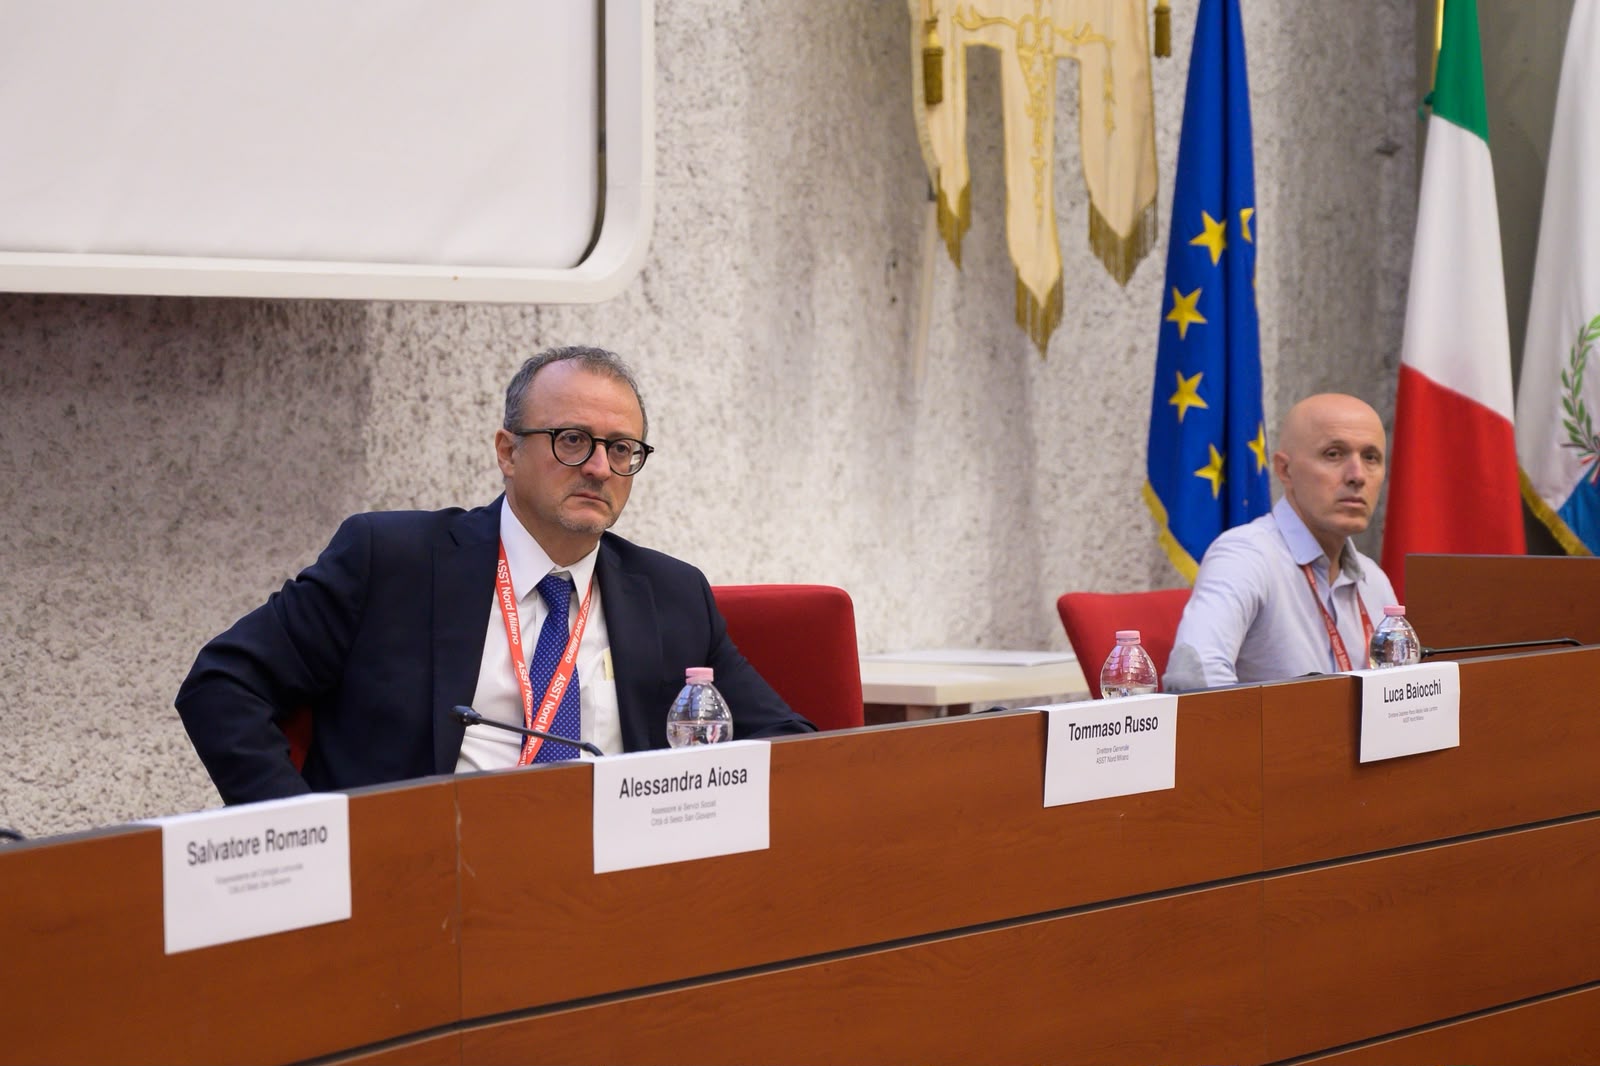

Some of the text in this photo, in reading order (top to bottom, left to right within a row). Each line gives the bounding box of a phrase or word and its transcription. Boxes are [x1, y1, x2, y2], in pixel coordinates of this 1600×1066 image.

[497, 559, 520, 645] ASST Nord Milano
[565, 632, 580, 663] Milano
[517, 660, 531, 688] ASST
[525, 688, 534, 716] Nord
[549, 672, 567, 701] ASST
[1383, 678, 1442, 703] Luca Baiocchi
[538, 700, 556, 724] Nord
[1068, 715, 1159, 742] Tommaso Russo
[619, 766, 748, 799] Alessandra Aiosa
[186, 825, 328, 866] Salvatore Romano
